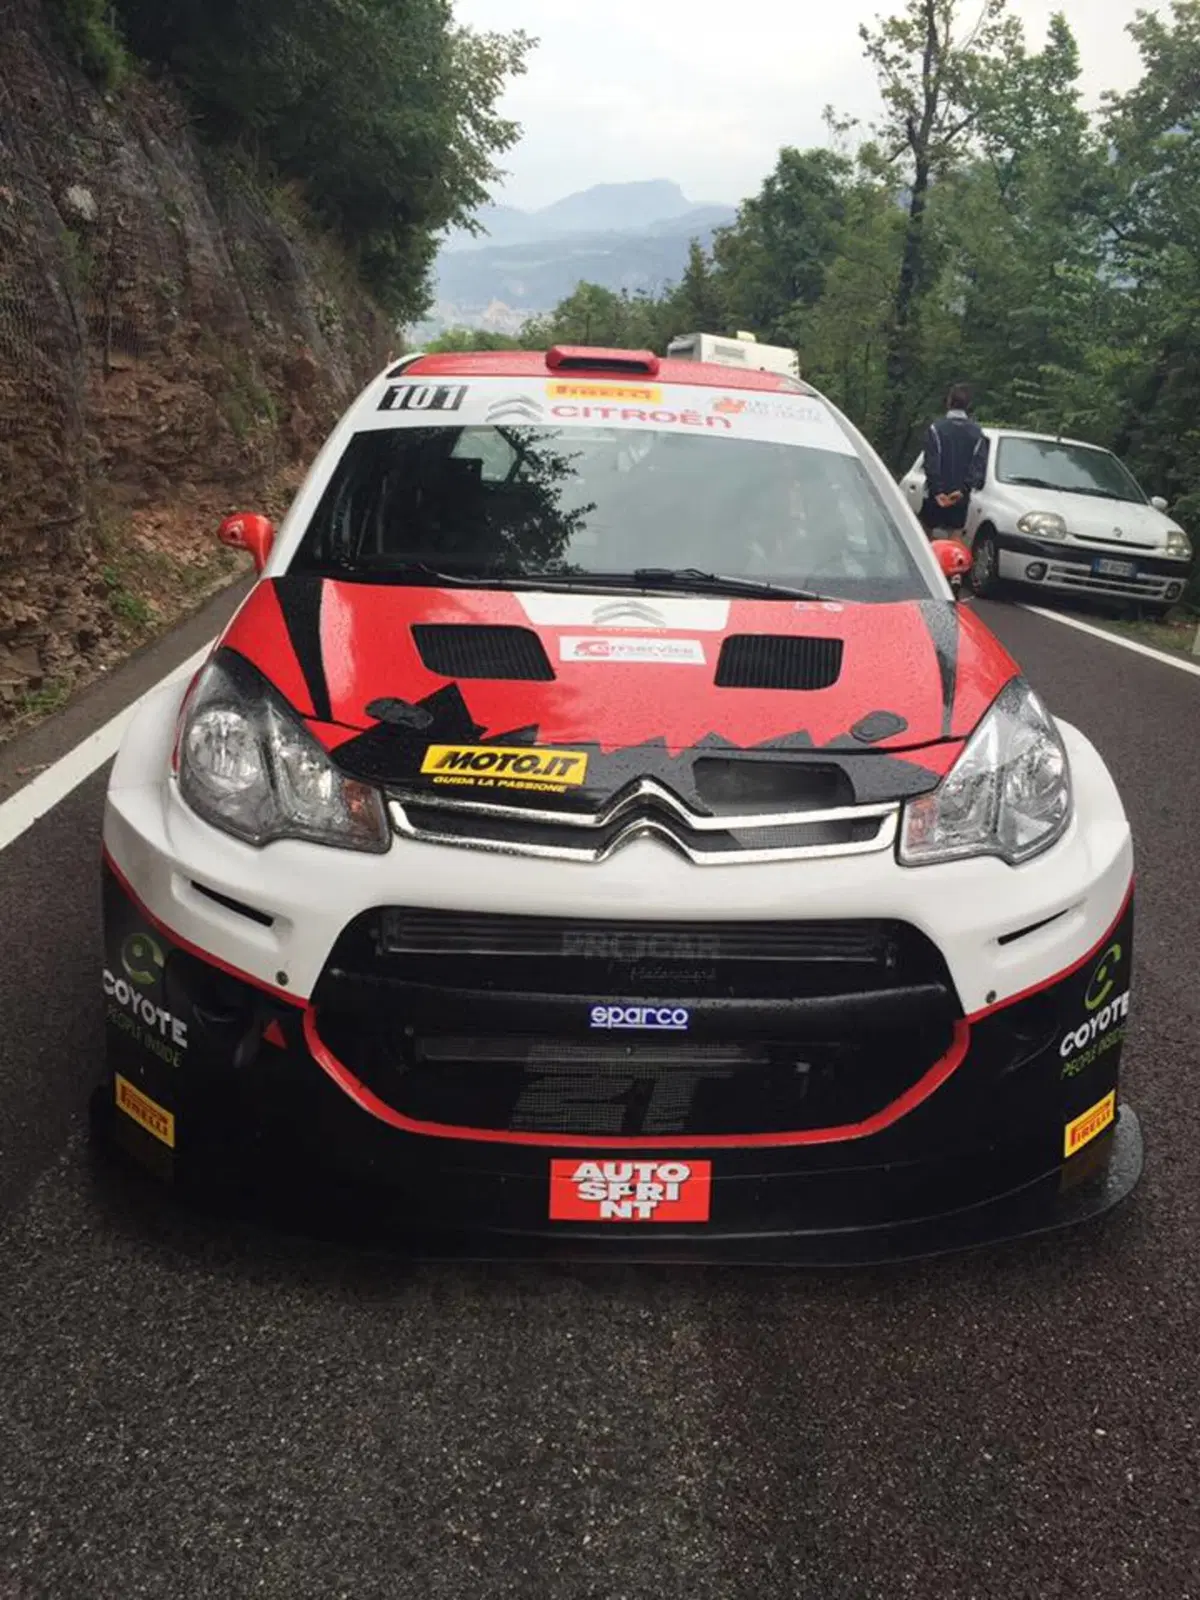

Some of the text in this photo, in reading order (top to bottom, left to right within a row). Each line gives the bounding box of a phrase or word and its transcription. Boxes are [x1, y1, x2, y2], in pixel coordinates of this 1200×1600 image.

[388, 385, 462, 409] 101
[433, 750, 580, 777] MOTO.IT
[432, 775, 568, 794] GUIDA LA PASSIONE
[103, 968, 188, 1049] COYOTE
[590, 1006, 689, 1029] sparco
[1059, 991, 1131, 1057] COYOTE
[119, 1083, 169, 1137] PIRELLI
[1070, 1100, 1112, 1147] PIRELLI
[570, 1161, 691, 1183] AUTO
[599, 1200, 659, 1219] NT
